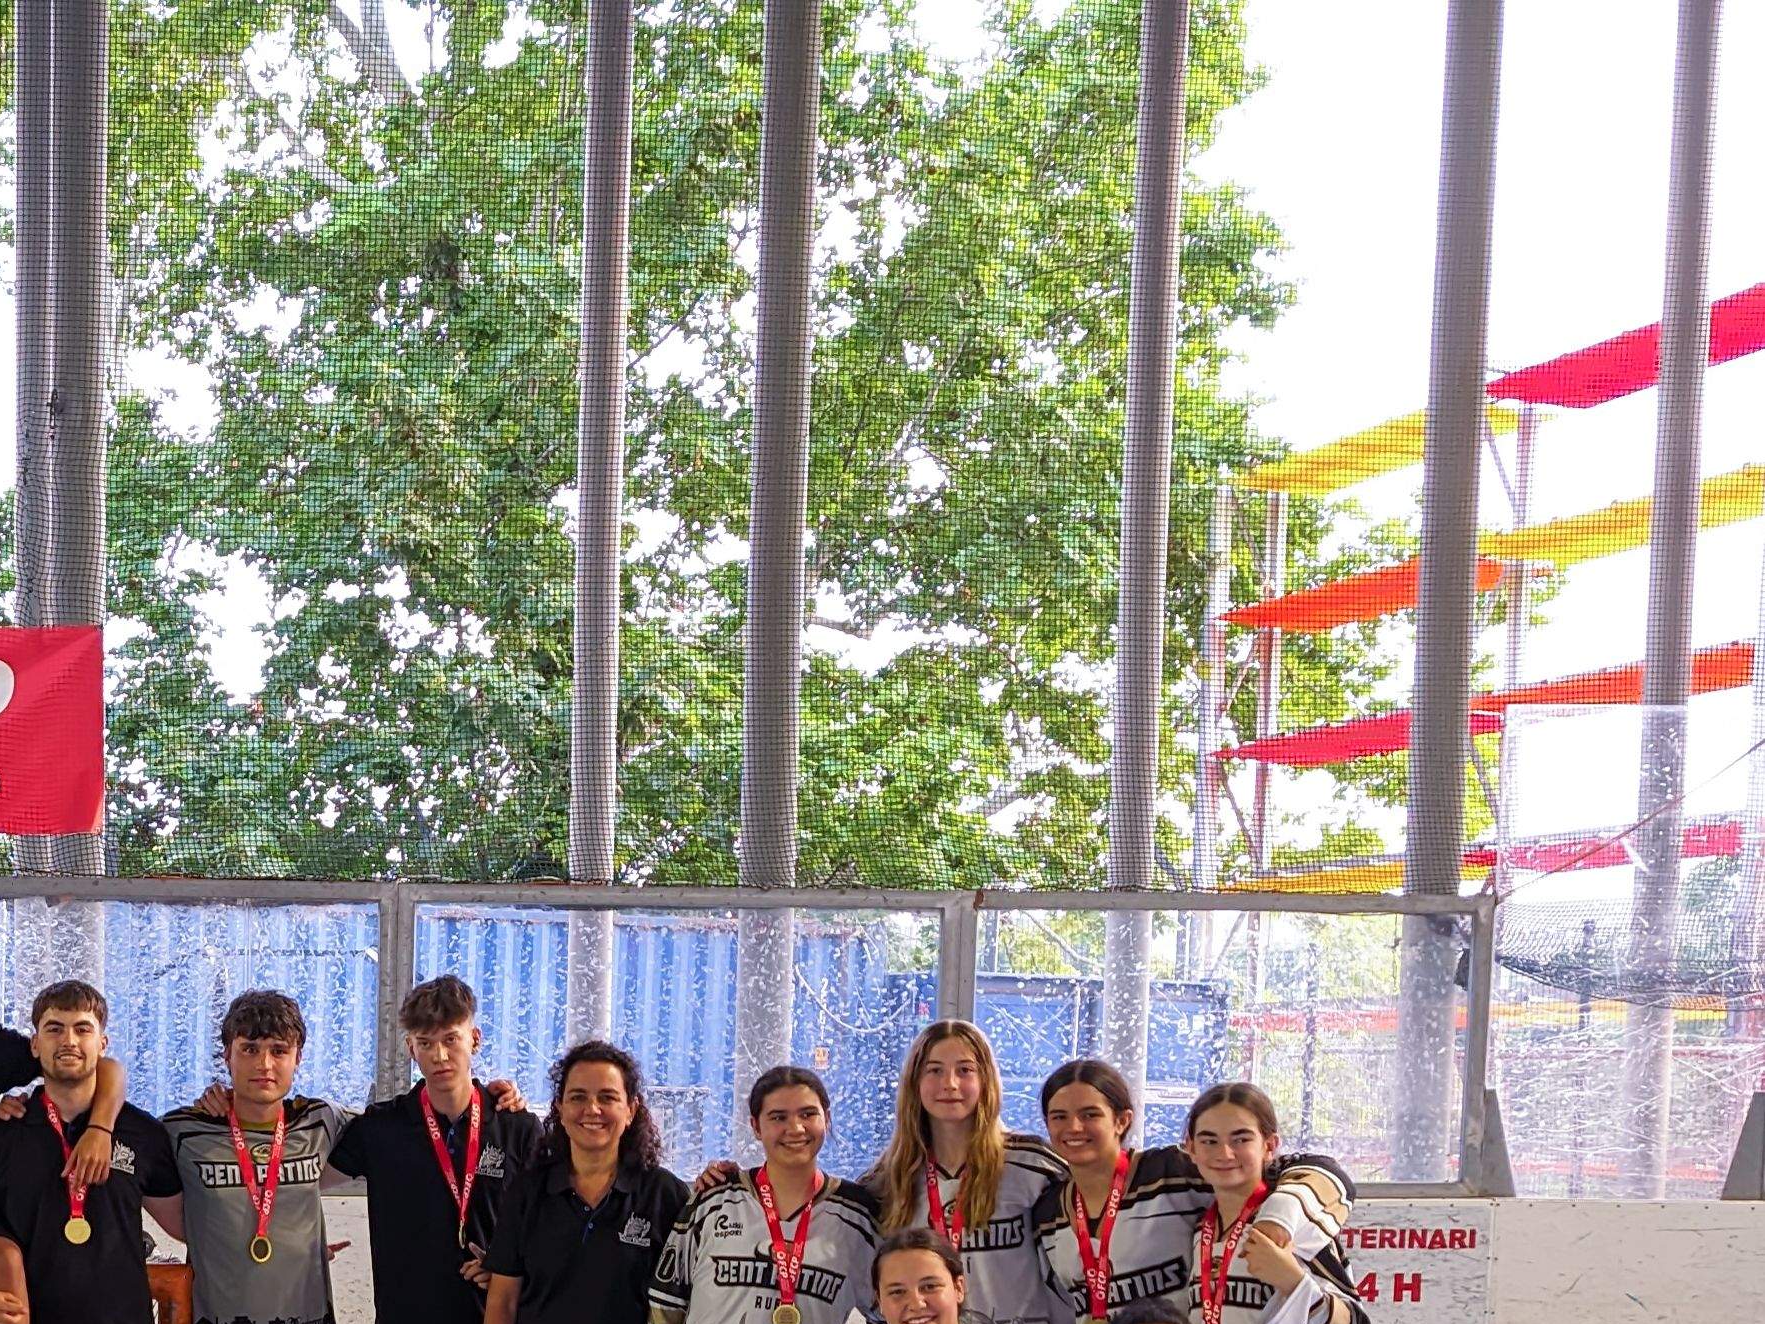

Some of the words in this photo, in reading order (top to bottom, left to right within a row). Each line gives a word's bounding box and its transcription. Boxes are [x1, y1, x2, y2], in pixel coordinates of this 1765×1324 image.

[1338, 1228, 1477, 1249] TERINARI
[1356, 1272, 1379, 1302] 4
[1393, 1272, 1422, 1302] H
